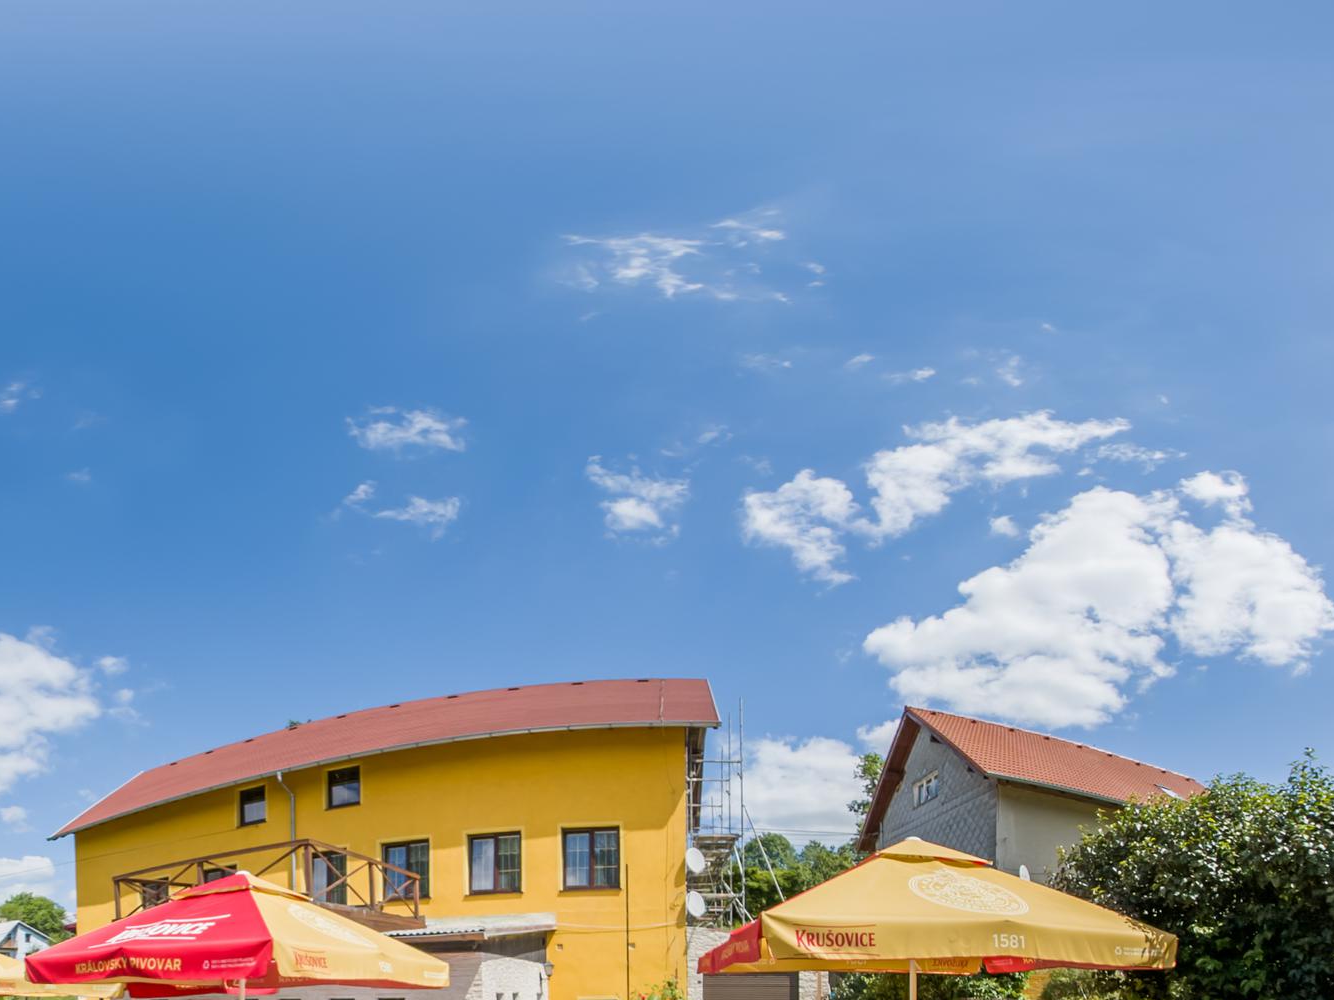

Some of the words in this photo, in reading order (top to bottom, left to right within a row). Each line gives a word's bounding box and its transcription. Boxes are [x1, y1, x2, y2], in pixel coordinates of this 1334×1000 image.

[795, 929, 877, 948] KRUŠOVICE
[992, 933, 1026, 948] 1581
[75, 956, 128, 974] KRÁLOVSKÝ
[129, 957, 182, 972] PIVOVAR
